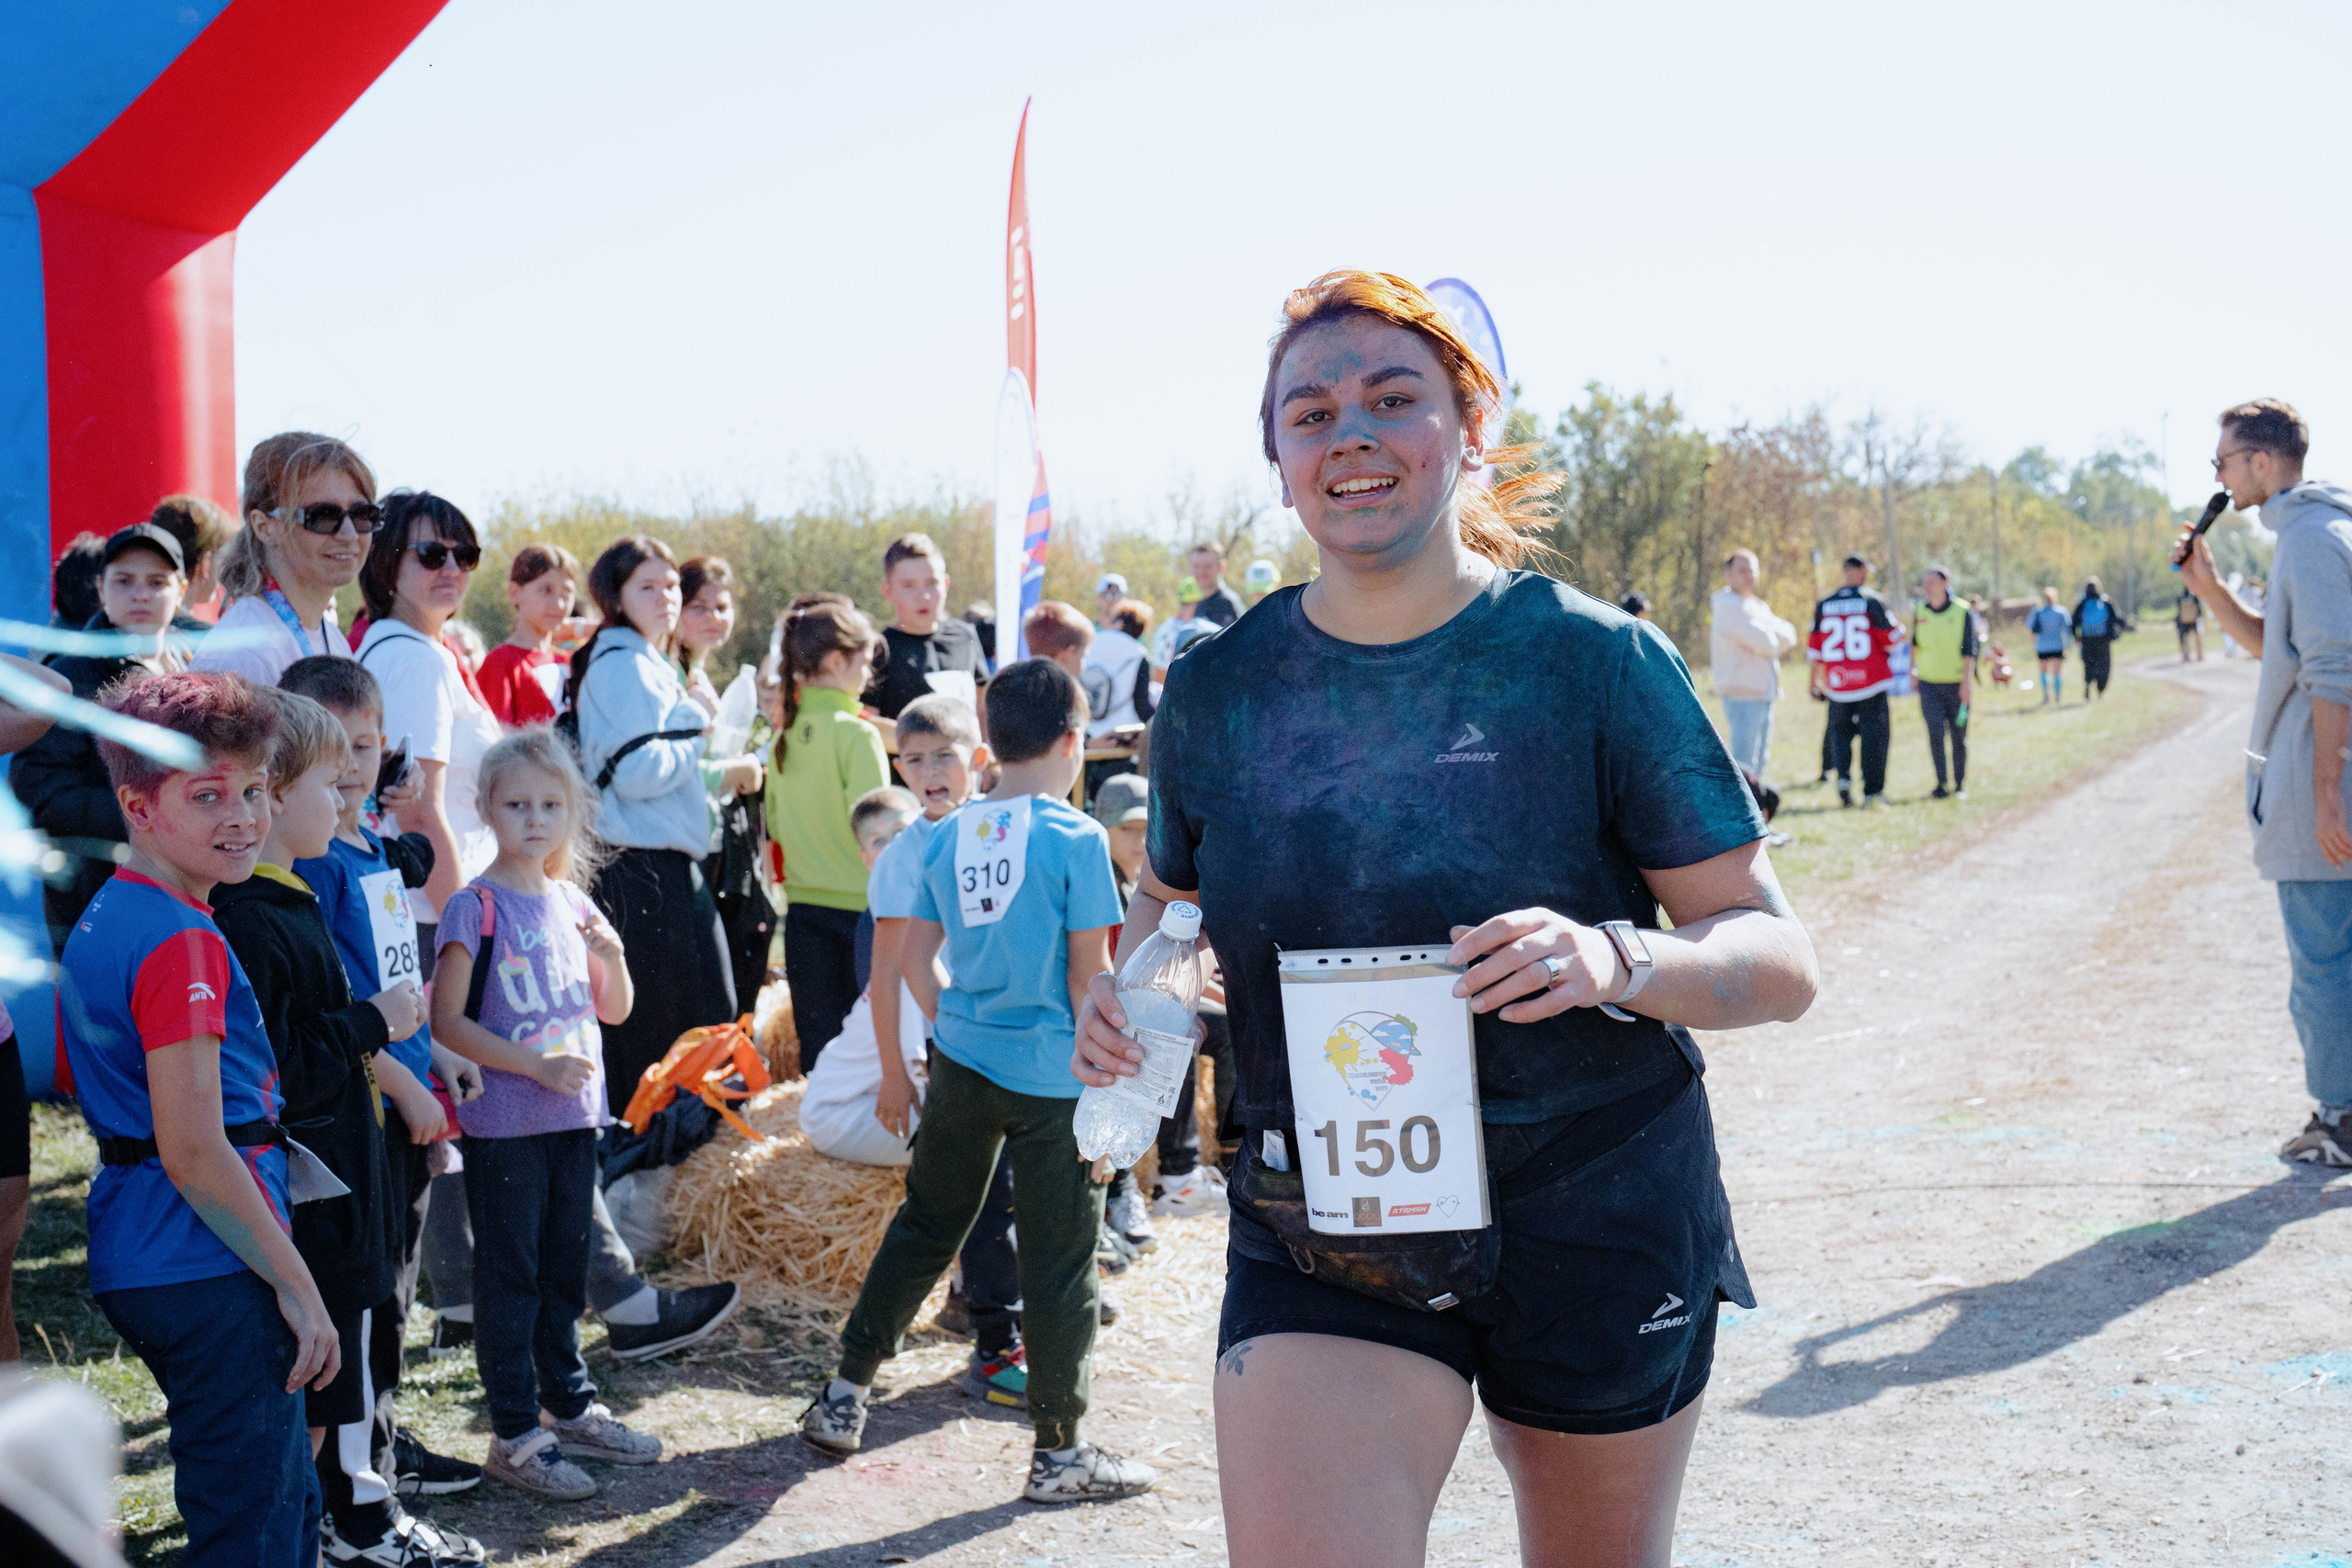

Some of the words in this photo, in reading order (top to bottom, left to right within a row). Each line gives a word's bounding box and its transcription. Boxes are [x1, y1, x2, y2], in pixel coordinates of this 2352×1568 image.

[1820, 615, 1871, 662] 26
[1434, 752, 1499, 763] DEMIX
[963, 859, 1010, 893] 310
[188, 991, 208, 1003] ANTA
[1314, 1115, 1442, 1178] 150
[1638, 1312, 1692, 1334] DEMIX
